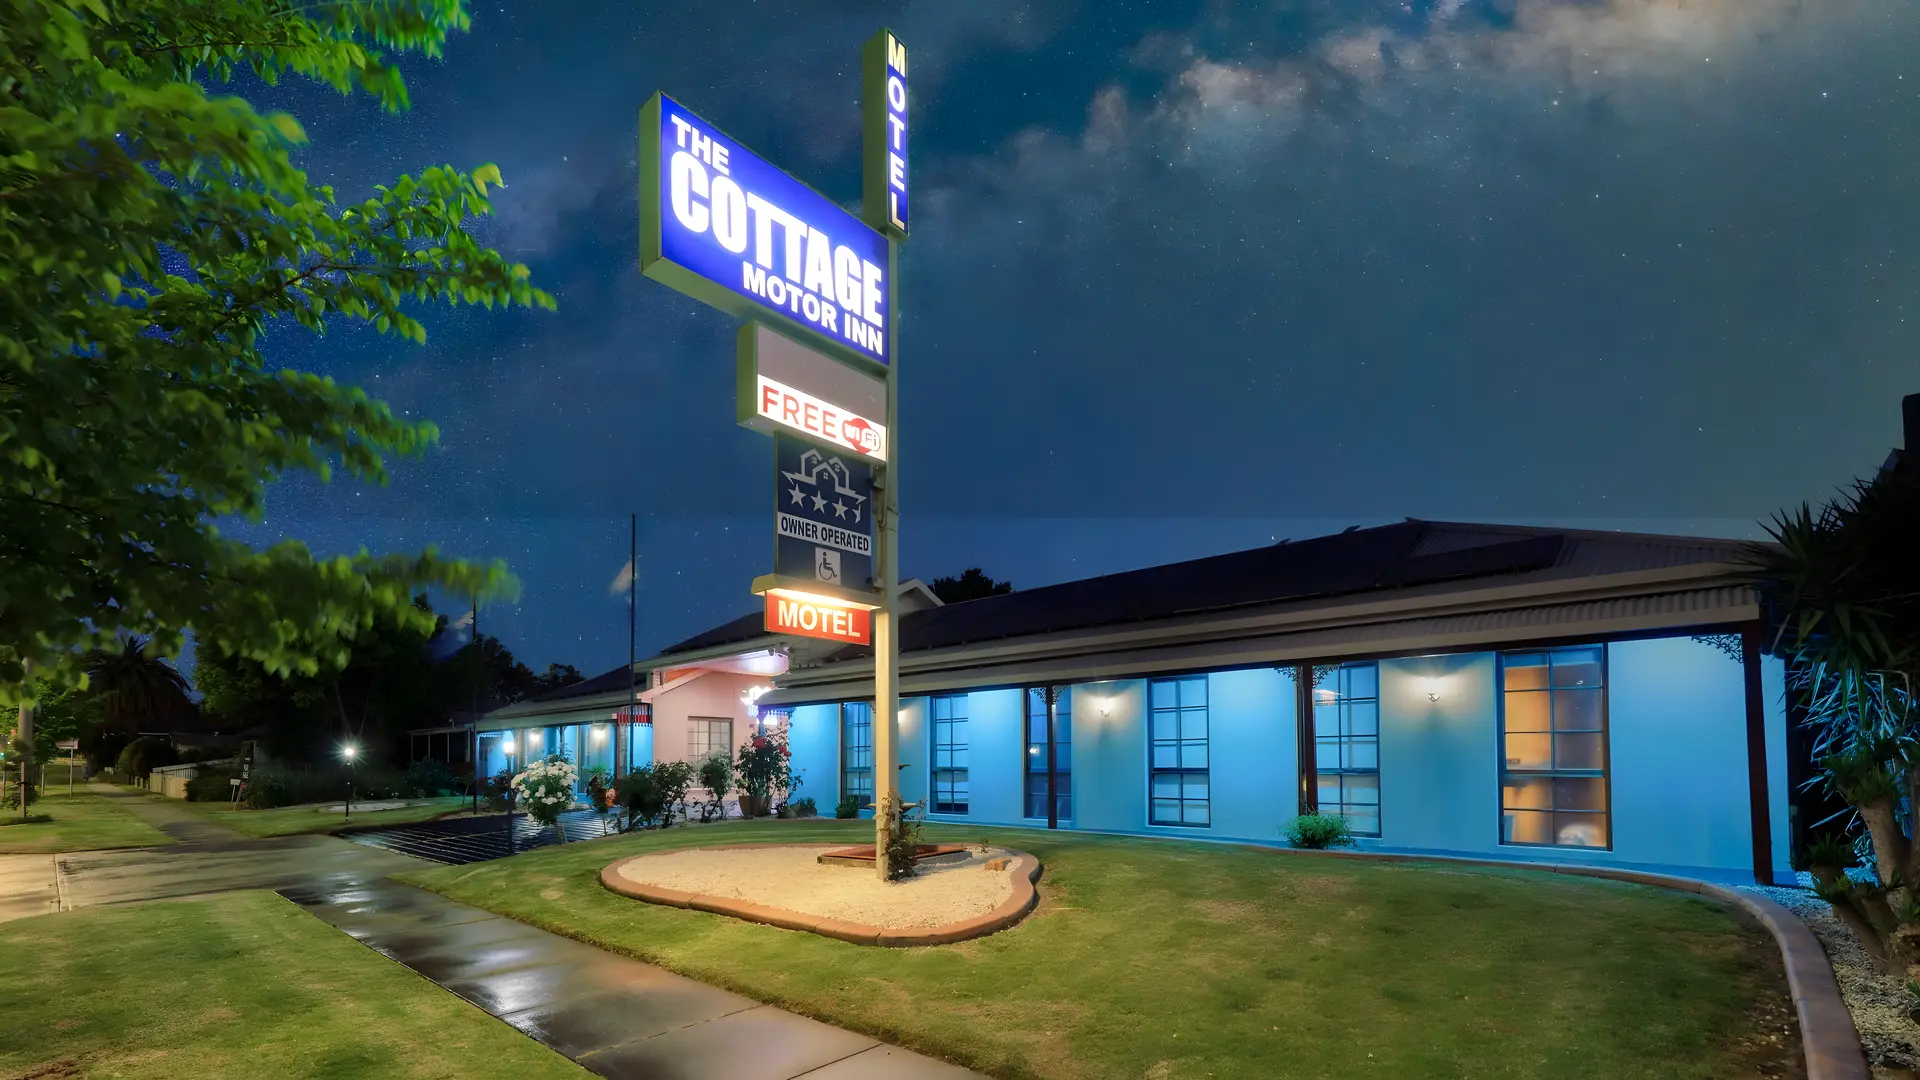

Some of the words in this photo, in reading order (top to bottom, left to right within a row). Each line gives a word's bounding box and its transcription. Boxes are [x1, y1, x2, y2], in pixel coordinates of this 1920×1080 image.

[671, 113, 730, 177] THE
[888, 32, 906, 230] MOTEL
[670, 150, 883, 328] COTTAGE
[743, 261, 838, 333] MOTOR
[844, 318, 883, 356] INN
[762, 384, 837, 440] FREE
[781, 516, 818, 540] OWNER
[821, 526, 869, 552] OPERATED
[778, 600, 861, 638] MOTEL
